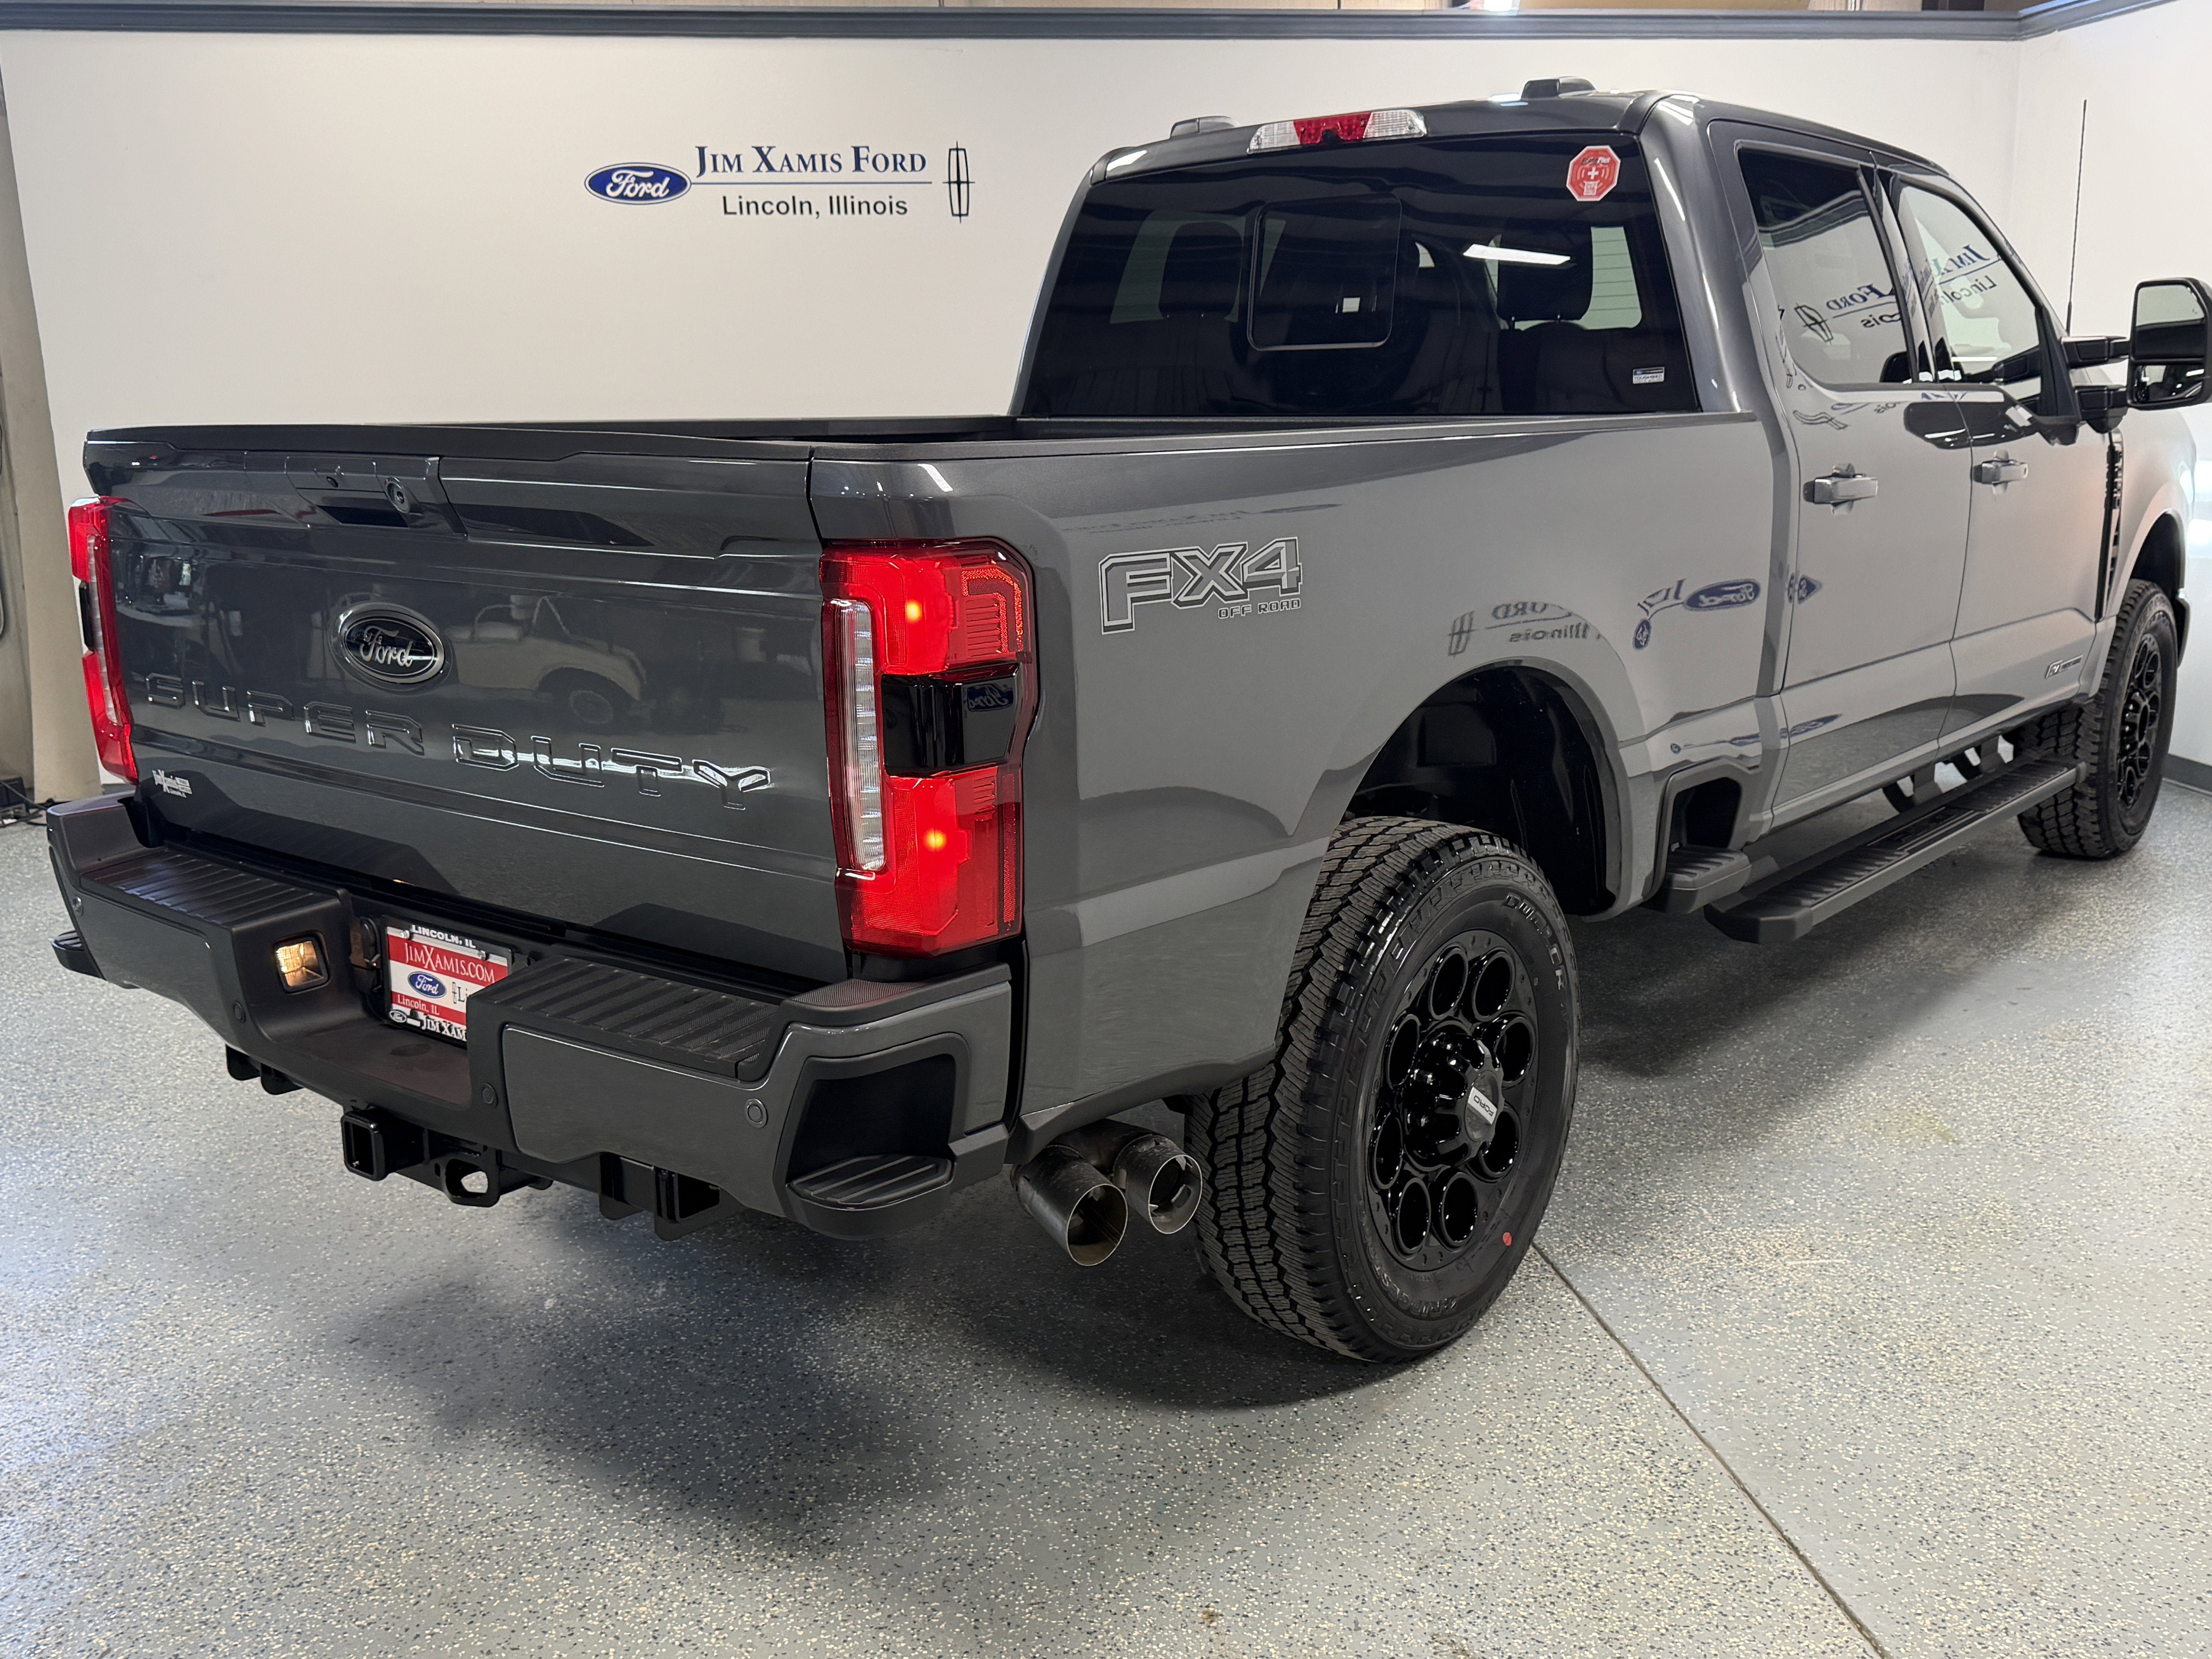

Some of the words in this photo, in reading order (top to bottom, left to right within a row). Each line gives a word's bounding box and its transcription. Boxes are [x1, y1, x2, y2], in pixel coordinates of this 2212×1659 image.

[695, 145, 744, 177] JIM
[752, 146, 842, 173] XAMIS
[851, 145, 927, 173] FORD
[605, 170, 669, 199] Ford
[722, 195, 821, 220] Lincoln,
[829, 196, 908, 216] Illinois
[1098, 536, 1302, 635] FX4
[1218, 604, 1252, 619] OFF
[1258, 598, 1301, 614] ROAD
[359, 625, 414, 667] Ford
[146, 673, 425, 756] SUPER
[452, 723, 771, 810] DUTY
[412, 924, 462, 945] LINCOLN,
[465, 939, 476, 948] IL
[415, 974, 439, 995] Ford
[398, 994, 429, 1012] Lincoln,
[431, 1005, 440, 1016] IL
[442, 1022, 467, 1042] XAM
[1473, 1094, 1494, 1117] FORD
